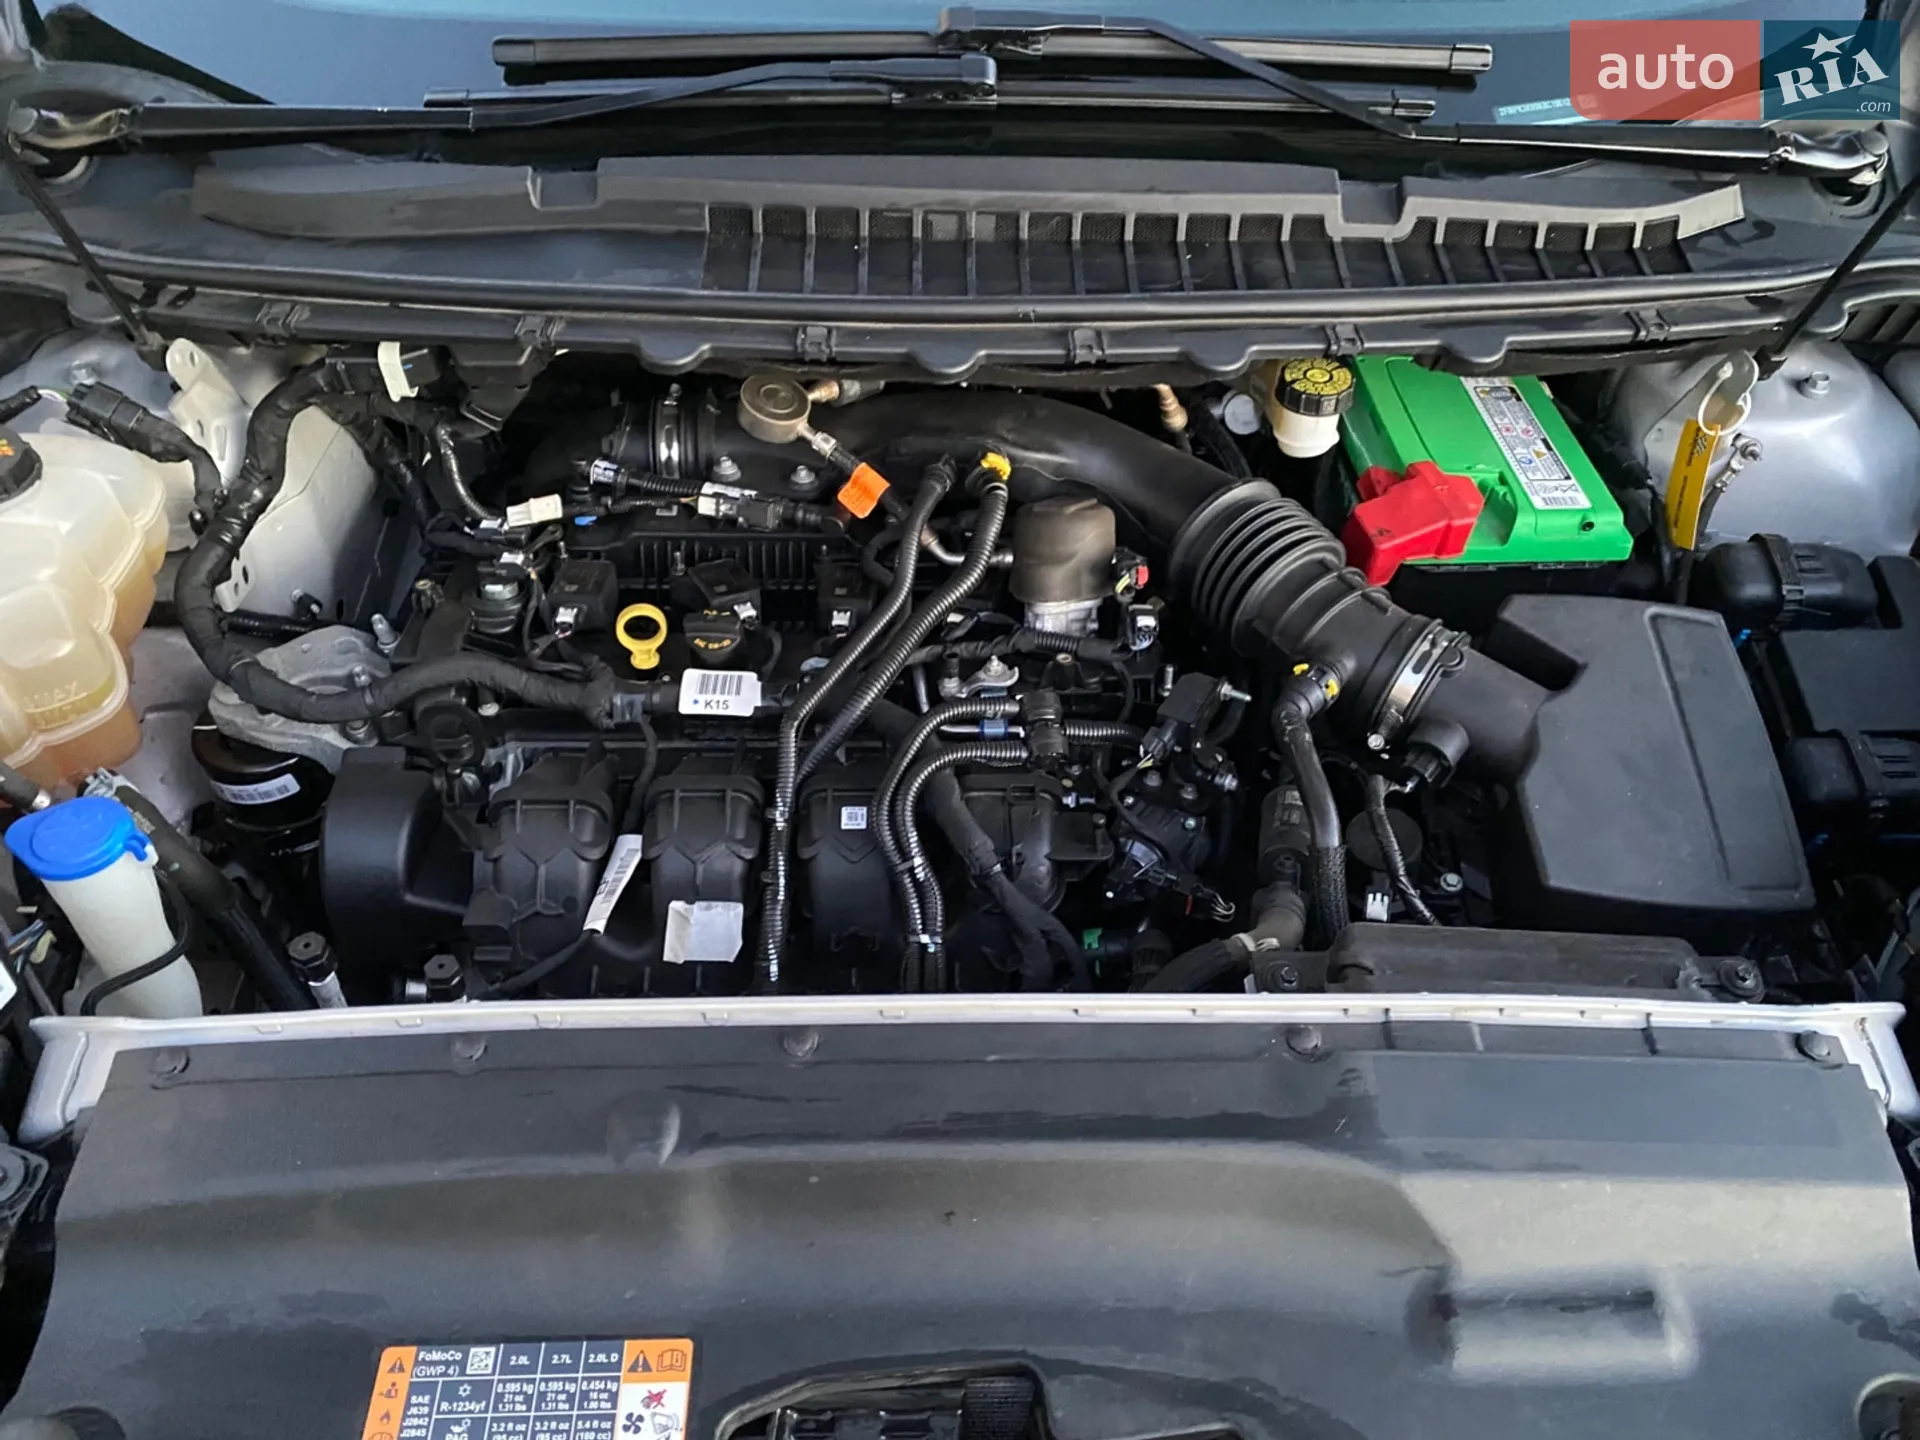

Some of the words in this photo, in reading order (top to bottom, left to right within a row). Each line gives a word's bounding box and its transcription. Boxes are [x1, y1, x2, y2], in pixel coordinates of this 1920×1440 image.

[704, 699, 730, 710] K15
[418, 1350, 462, 1361] FoMoCo
[509, 1355, 530, 1365] 2.0L
[551, 1354, 572, 1364] 2.7L
[588, 1353, 609, 1363] 2.0L
[610, 1352, 619, 1362] D
[412, 1365, 446, 1378] (GWP
[446, 1364, 460, 1377] 4)
[522, 1382, 534, 1394] kg
[565, 1381, 576, 1393] kg
[581, 1380, 605, 1390] 0.454
[606, 1380, 618, 1392] kg
[410, 1395, 431, 1404] SAE
[439, 1400, 486, 1413] R-1234yf
[491, 1423, 506, 1432] 3.2
[534, 1422, 549, 1430] 3.2
[576, 1420, 591, 1429] 5.4
[600, 1421, 612, 1429] oz
